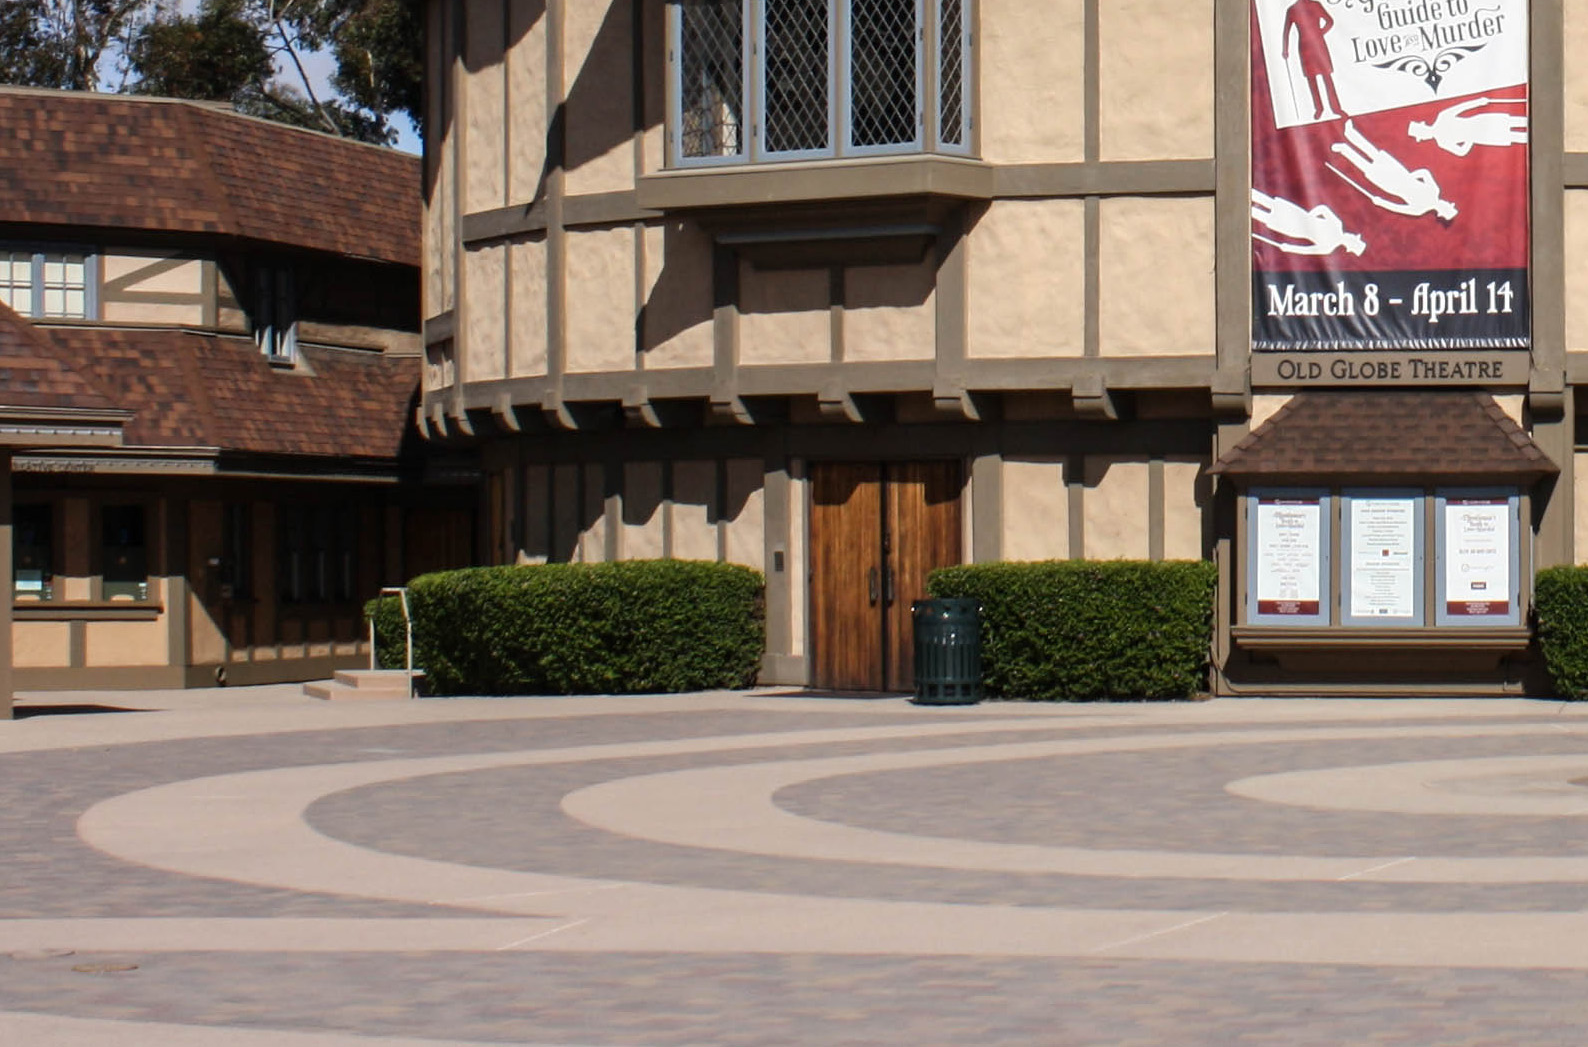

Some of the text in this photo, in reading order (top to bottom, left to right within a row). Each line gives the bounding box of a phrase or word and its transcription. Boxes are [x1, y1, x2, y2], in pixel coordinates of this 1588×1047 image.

[1351, 33, 1402, 63] Love
[1418, 5, 1505, 51] Murder
[1267, 281, 1354, 316] March
[1364, 284, 1380, 316] 8
[1411, 278, 1478, 323] April
[1487, 281, 1514, 314] 14
[1277, 358, 1503, 379] OLD GLOBE THEATRE
